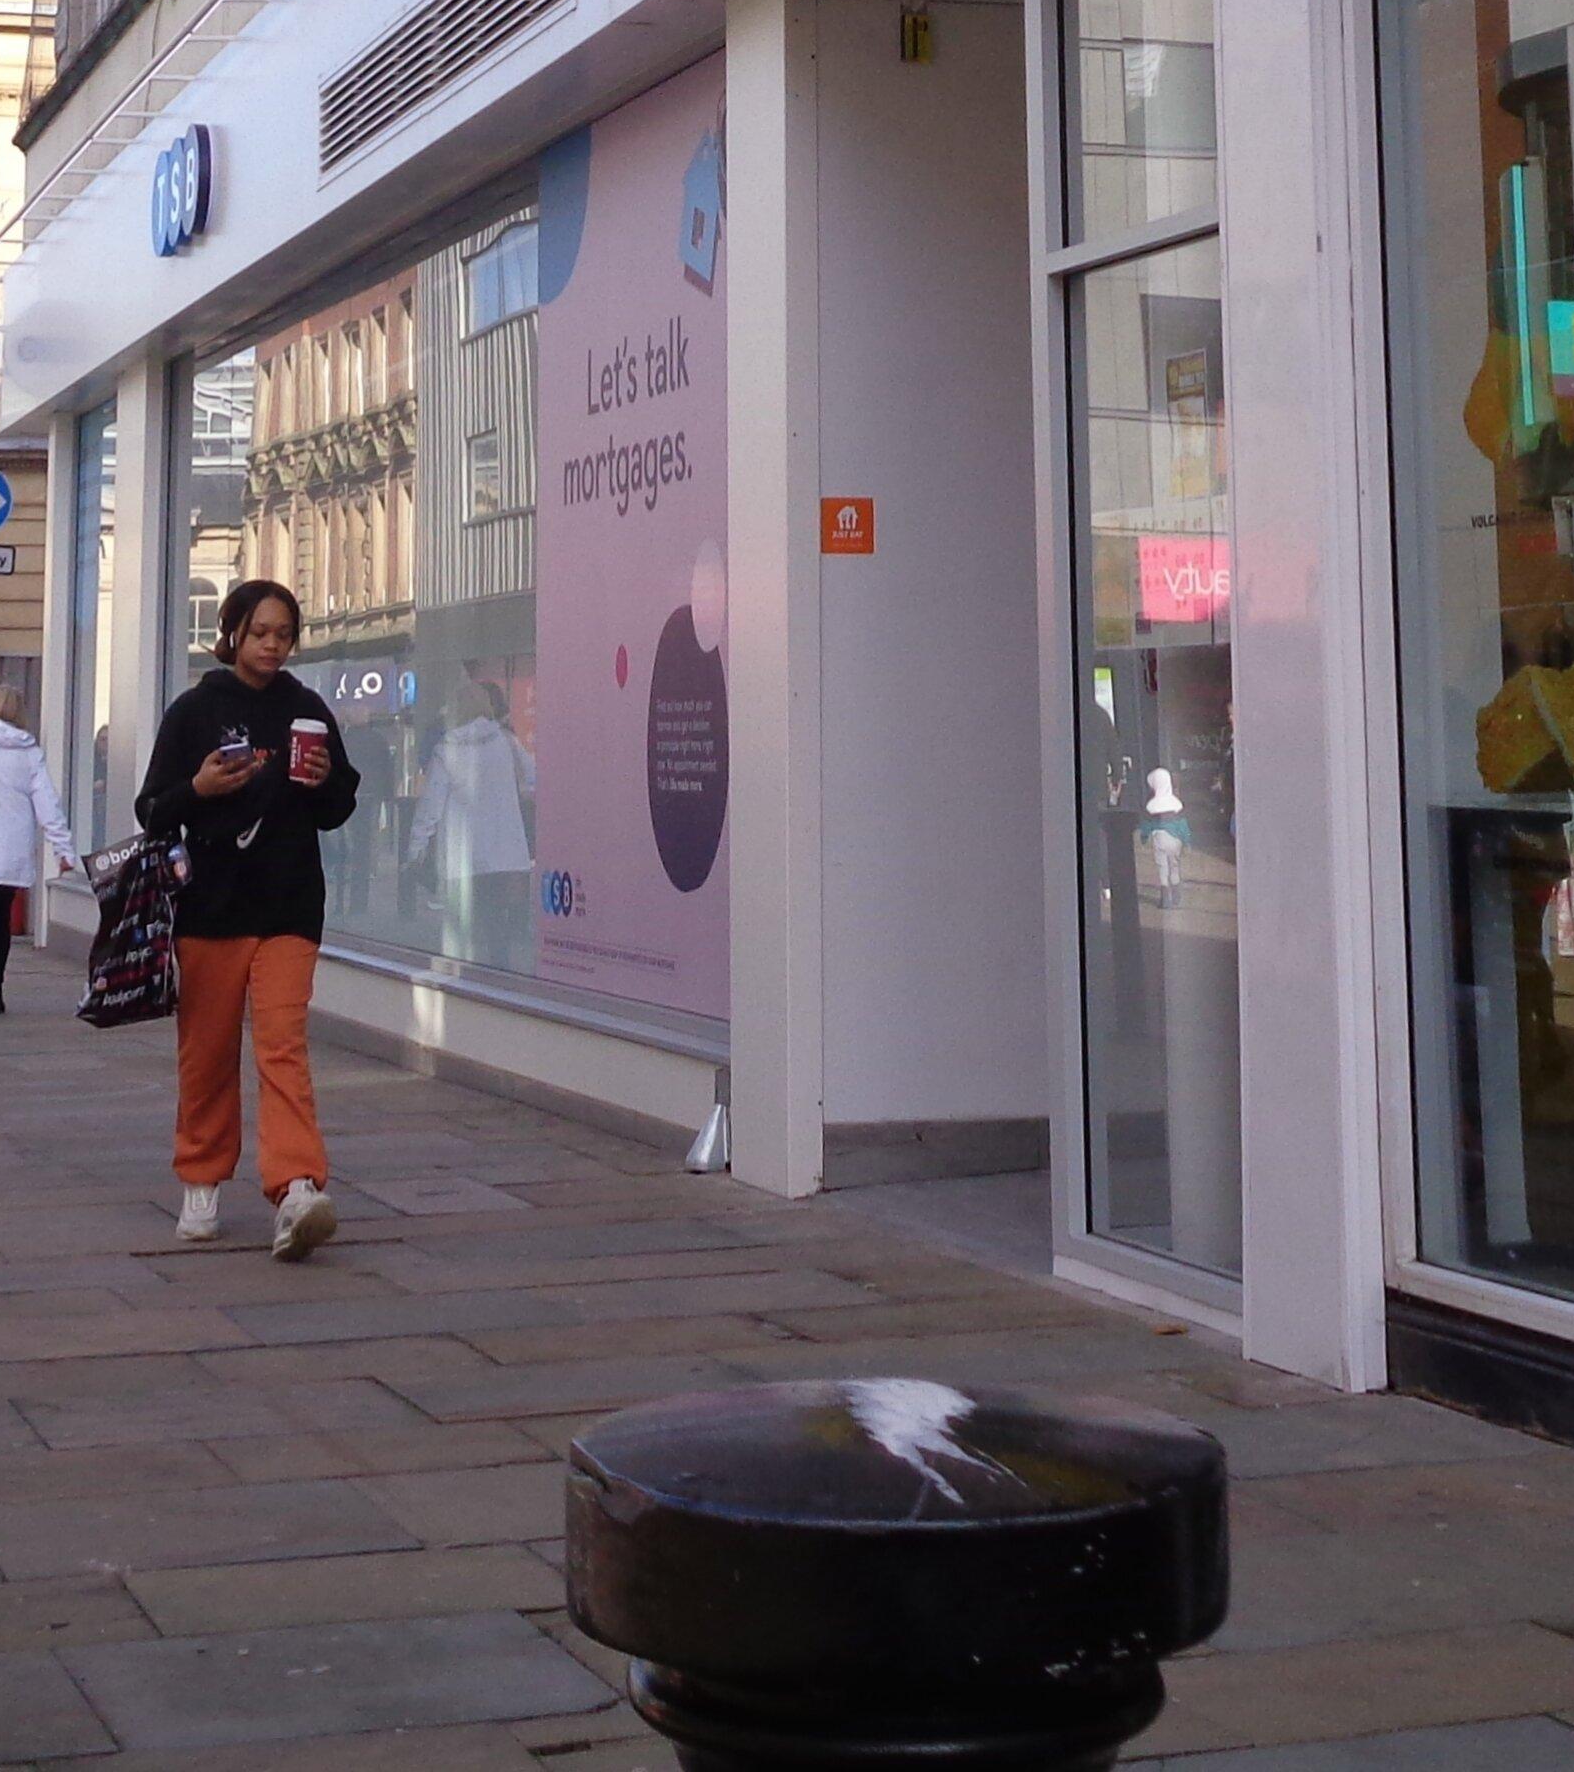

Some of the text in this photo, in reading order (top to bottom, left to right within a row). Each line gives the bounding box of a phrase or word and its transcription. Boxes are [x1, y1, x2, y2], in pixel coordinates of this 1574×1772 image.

[156, 147, 196, 234] TSB
[587, 315, 690, 416] Let's talk
[563, 430, 692, 517] mortgages.
